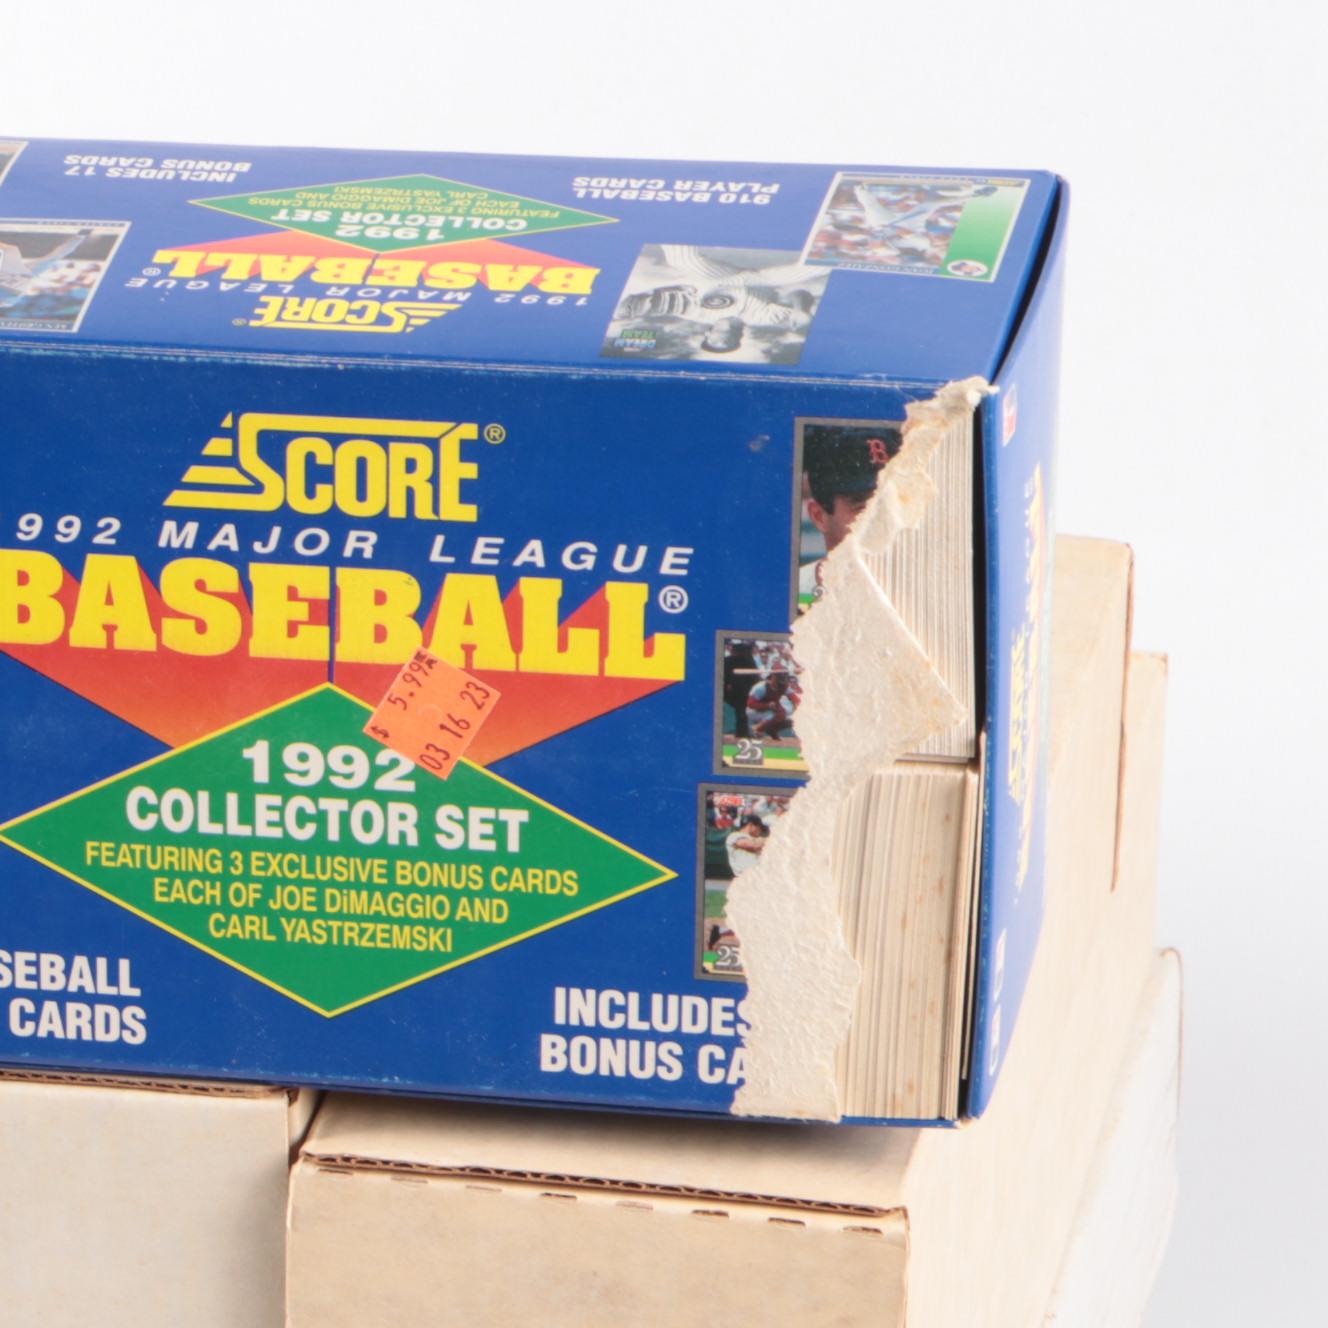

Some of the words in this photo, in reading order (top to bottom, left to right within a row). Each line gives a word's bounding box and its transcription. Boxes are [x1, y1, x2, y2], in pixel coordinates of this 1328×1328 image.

[64, 155, 154, 168] CARDS
[162, 158, 251, 172] BONUS
[65, 165, 96, 176] 17
[105, 167, 236, 182] INCLUDES
[572, 176, 663, 190] CARDS
[674, 180, 780, 194] PLAYER
[248, 197, 303, 207] CARDS
[575, 187, 711, 204] BASEBALL
[719, 193, 771, 205] 910
[306, 199, 364, 210] BONUS
[271, 208, 331, 222] SET
[342, 211, 528, 231] COLLECTOR
[335, 225, 445, 241] 1992
[152, 250, 601, 295] BASEBALL
[124, 277, 295, 294] LEAGUE
[326, 285, 472, 302] MAJOR
[494, 295, 589, 307] 1992
[249, 295, 462, 333] SCORE
[162, 411, 478, 522] SCORE
[158, 520, 379, 559] MAJOR
[429, 535, 694, 576] LEAGUE
[419, 743, 451, 771] 03
[439, 713, 471, 739] 16
[459, 681, 491, 711] 23
[735, 738, 763, 762] 25
[242, 739, 416, 793] 1992
[126, 786, 419, 847] COLLECTOR
[434, 804, 529, 853] SET
[86, 841, 223, 874] FEATURING
[230, 851, 243, 875] 3
[250, 852, 388, 884] EXCLUSIVE
[396, 861, 484, 890] BONUS
[491, 866, 579, 897] CARDS
[154, 877, 221, 905] EACH
[228, 882, 262, 908] OF
[269, 885, 318, 912] JOE
[325, 888, 451, 921] DiMAGGIO
[455, 898, 509, 924] AND
[208, 913, 277, 941] CARL
[280, 918, 452, 953] YASTRZEMSKI
[8, 998, 148, 1045] CARDS
[540, 1033, 684, 1081] BONUS
